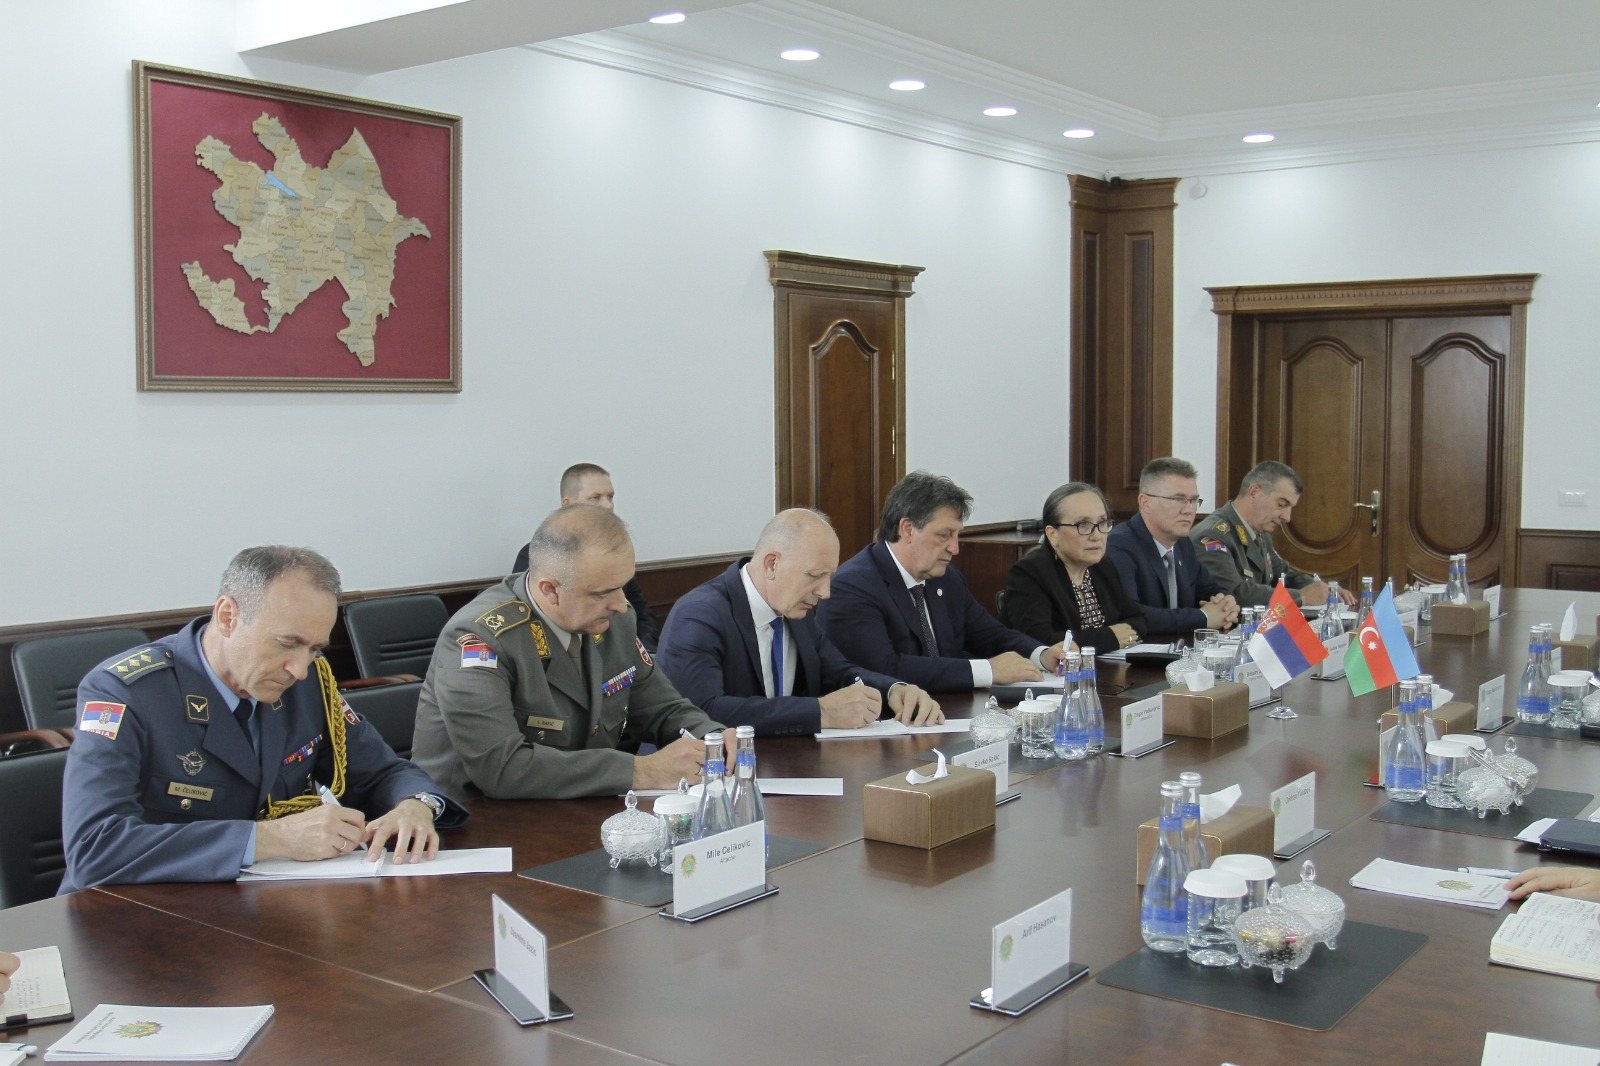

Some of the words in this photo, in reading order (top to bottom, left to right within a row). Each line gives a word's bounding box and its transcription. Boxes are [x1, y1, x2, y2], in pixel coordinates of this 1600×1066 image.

[706, 849, 721, 860] Mile
[721, 839, 751, 855] Celikovic
[1033, 914, 1057, 933] Hasanov
